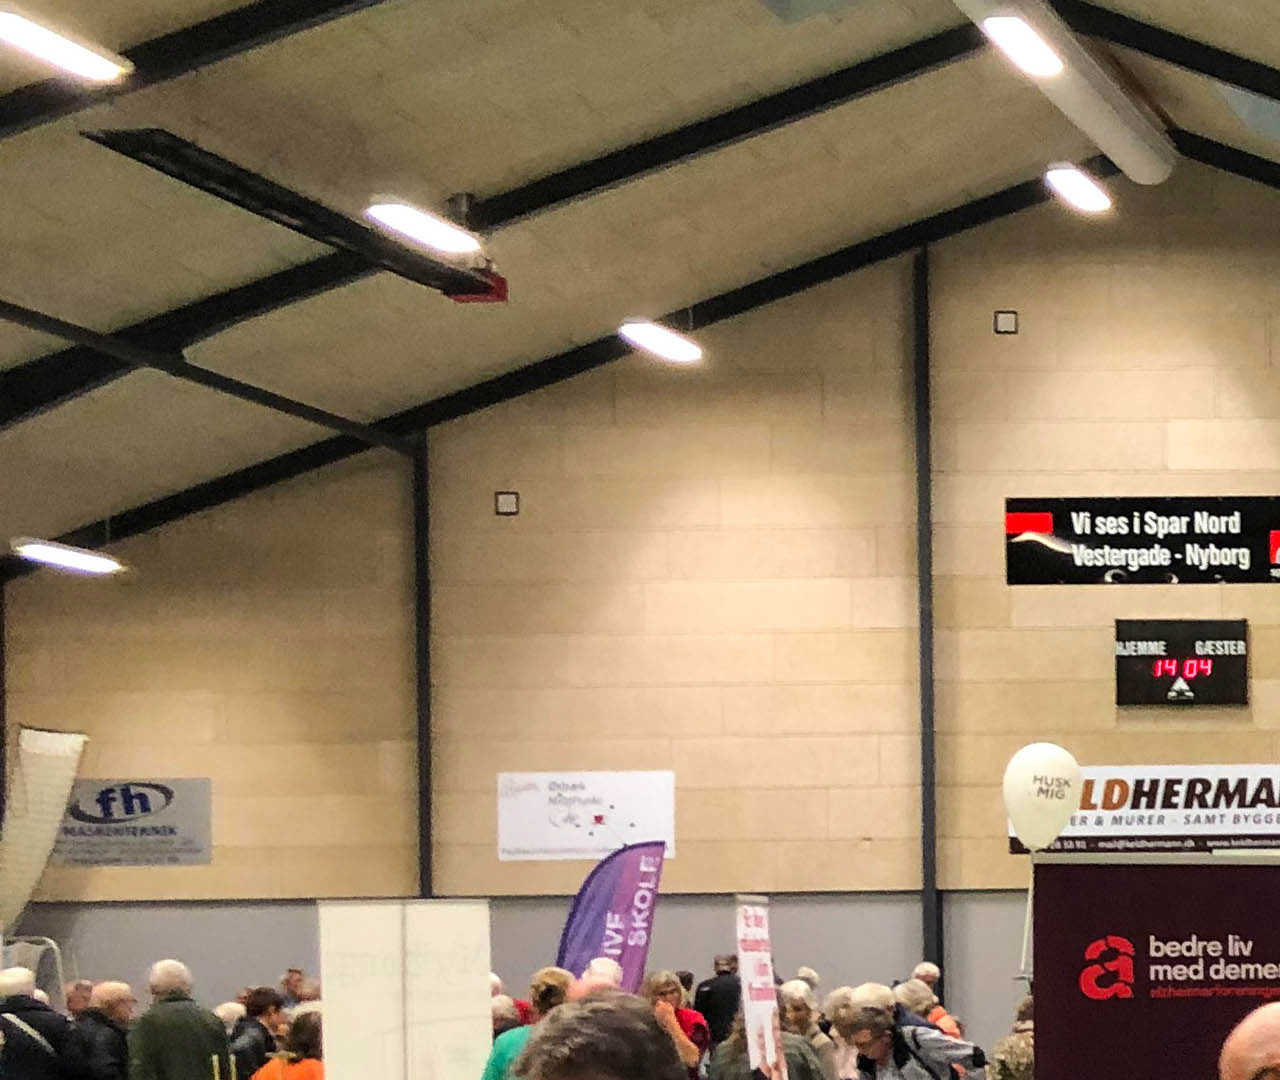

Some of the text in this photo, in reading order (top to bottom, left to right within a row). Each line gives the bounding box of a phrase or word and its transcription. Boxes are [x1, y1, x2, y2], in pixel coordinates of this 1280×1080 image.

[1071, 511, 1242, 539] Vi ses i Spar Nord
[1072, 545, 1172, 571] Vestergade
[1185, 544, 1250, 571] Nyborg
[1195, 640, 1246, 656] GÆSTER
[1032, 775, 1072, 788] HUSK
[1037, 786, 1065, 800] MIG
[96, 784, 152, 818] fh
[1111, 815, 1165, 827] MURER
[1184, 814, 1226, 827] SAMT
[1149, 935, 1223, 958] bedre
[1228, 934, 1253, 957] liv
[1149, 958, 1205, 982] med
